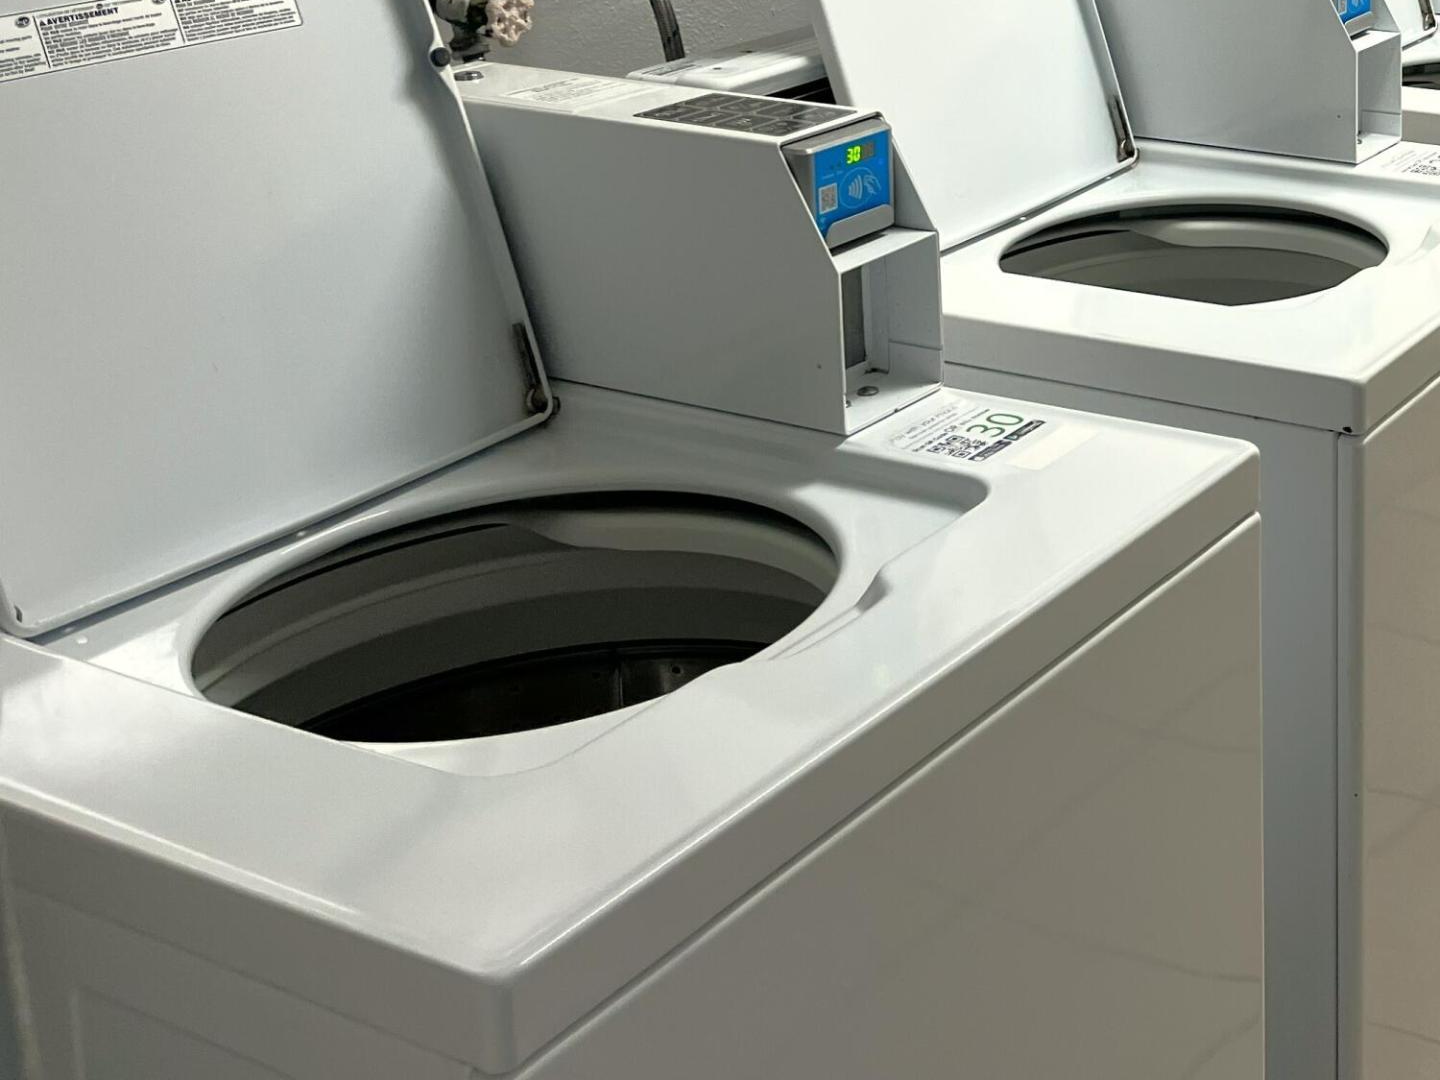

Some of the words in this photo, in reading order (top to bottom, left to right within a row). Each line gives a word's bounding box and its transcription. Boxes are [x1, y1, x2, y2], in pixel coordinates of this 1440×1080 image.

[47, 6, 119, 26] AVERTISSEMENT
[846, 144, 862, 165] 30
[966, 413, 1025, 438] 30
